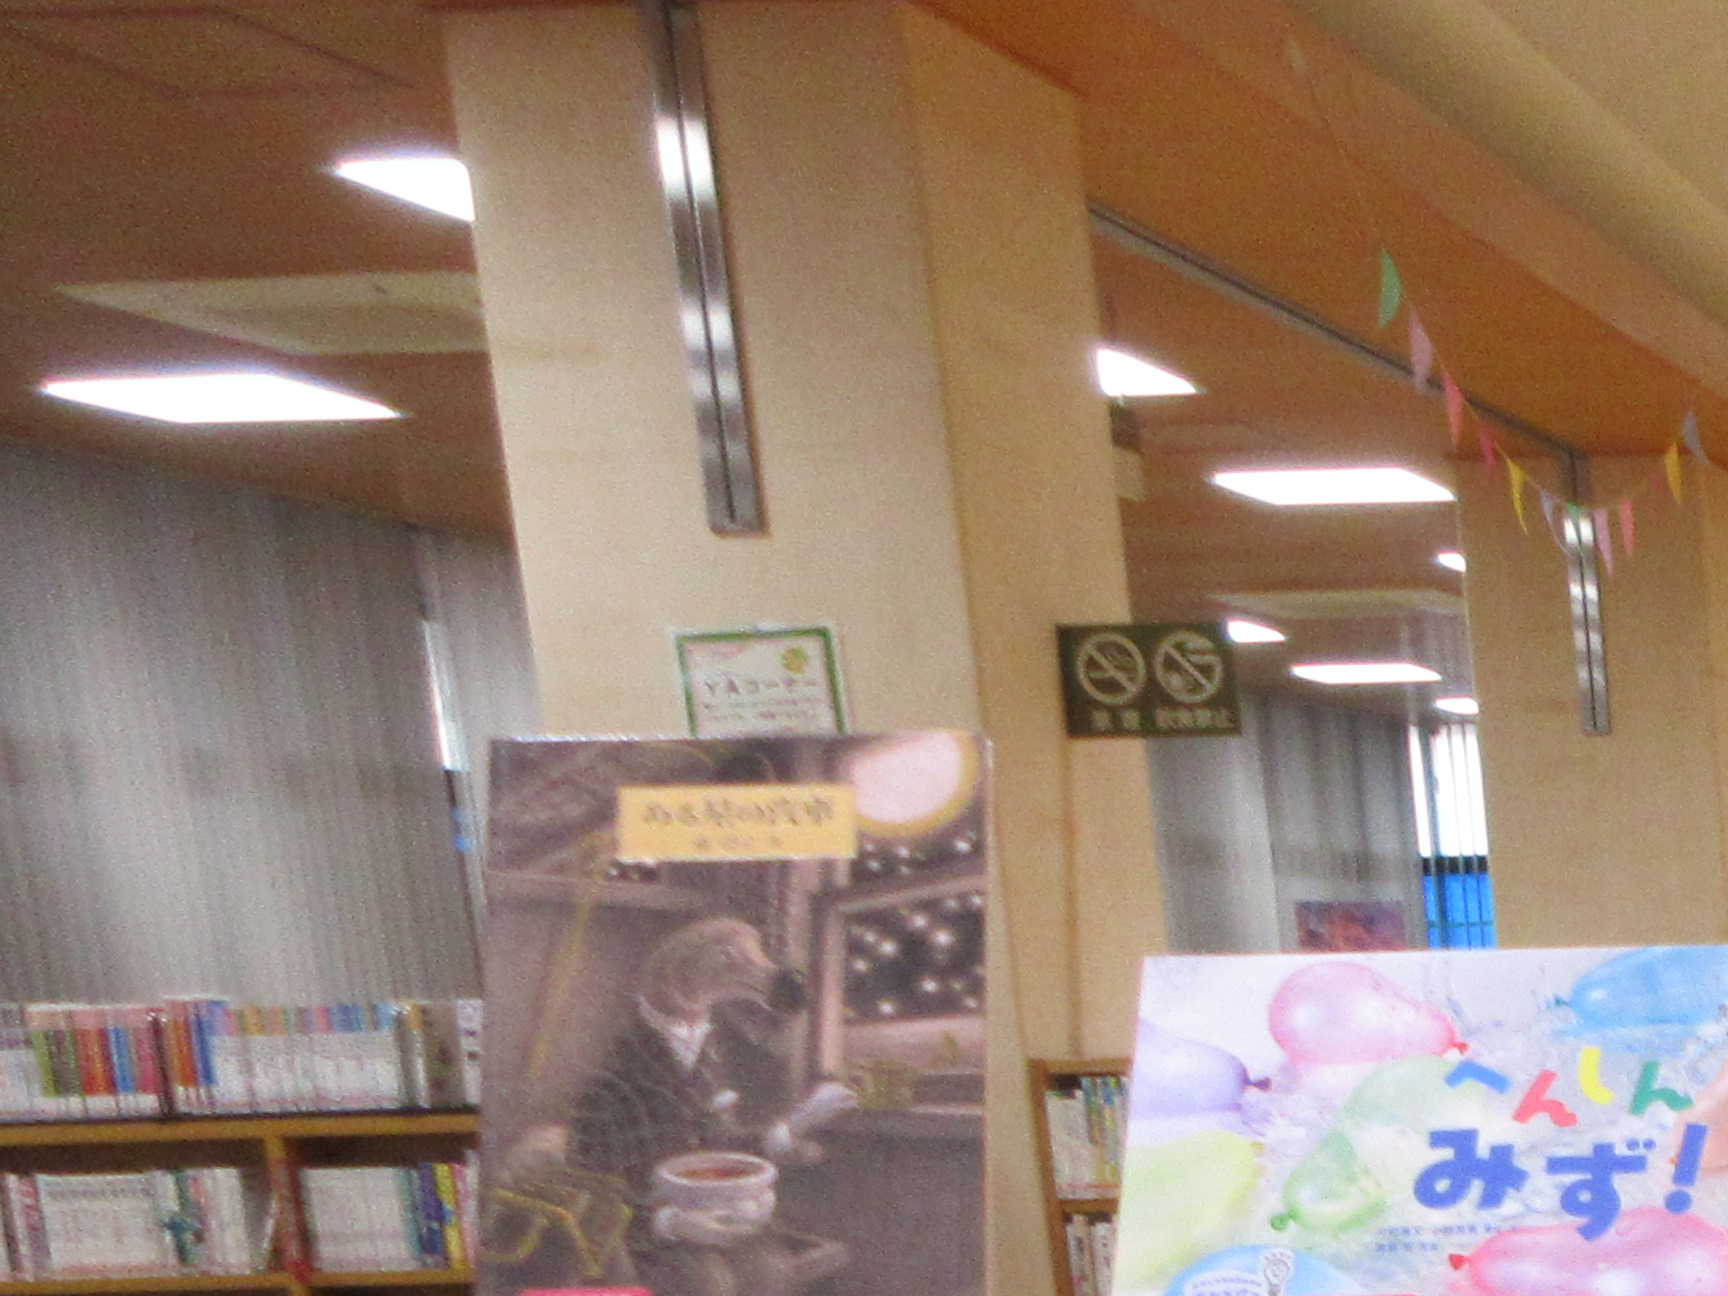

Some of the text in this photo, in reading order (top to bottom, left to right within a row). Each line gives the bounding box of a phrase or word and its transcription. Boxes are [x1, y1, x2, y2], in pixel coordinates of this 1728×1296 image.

[1443, 1047, 1696, 1128] へんしん
[1413, 1123, 1708, 1242] みず!
